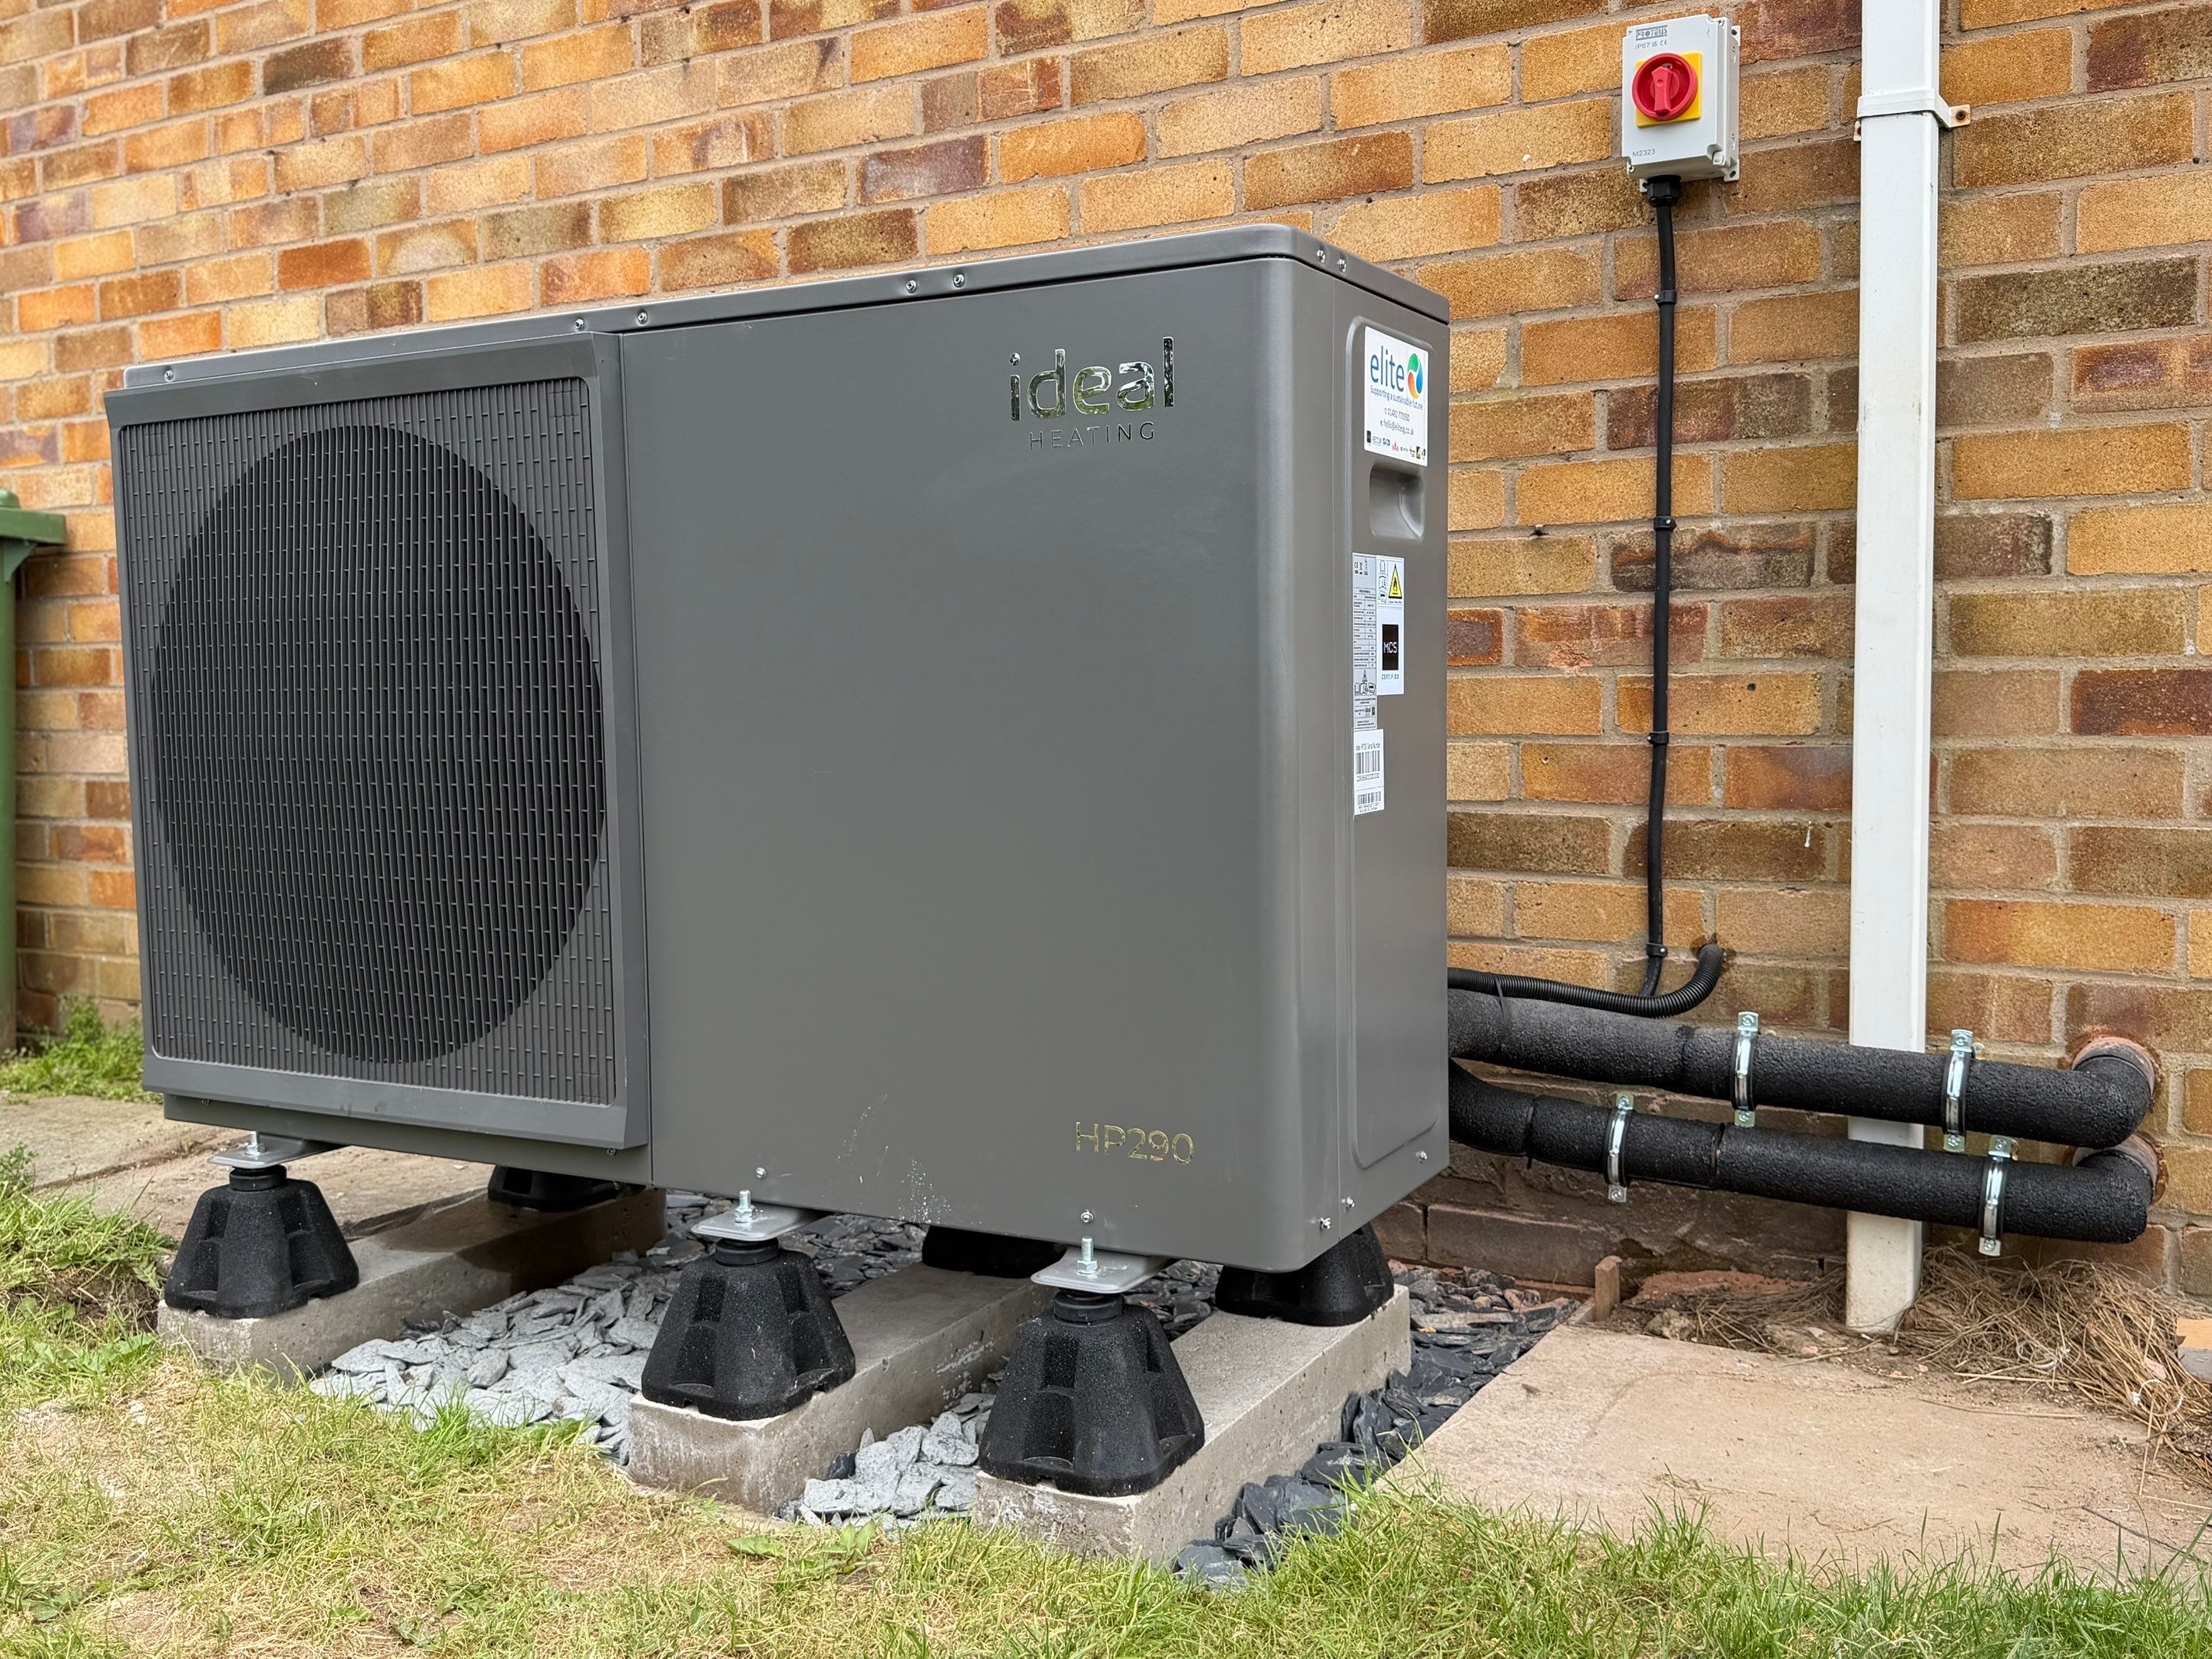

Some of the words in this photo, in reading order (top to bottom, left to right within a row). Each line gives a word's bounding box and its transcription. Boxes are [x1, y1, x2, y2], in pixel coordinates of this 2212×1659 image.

[1636, 27, 1667, 39] PROTEUS
[1632, 148, 1656, 157] M2323
[1008, 336, 1174, 421] ideal
[1370, 345, 1405, 392] elite
[1370, 385, 1389, 401] Supporting
[1030, 421, 1155, 449] HEATING
[1383, 641, 1397, 654] MCS
[1075, 1121, 1194, 1164] HP290
